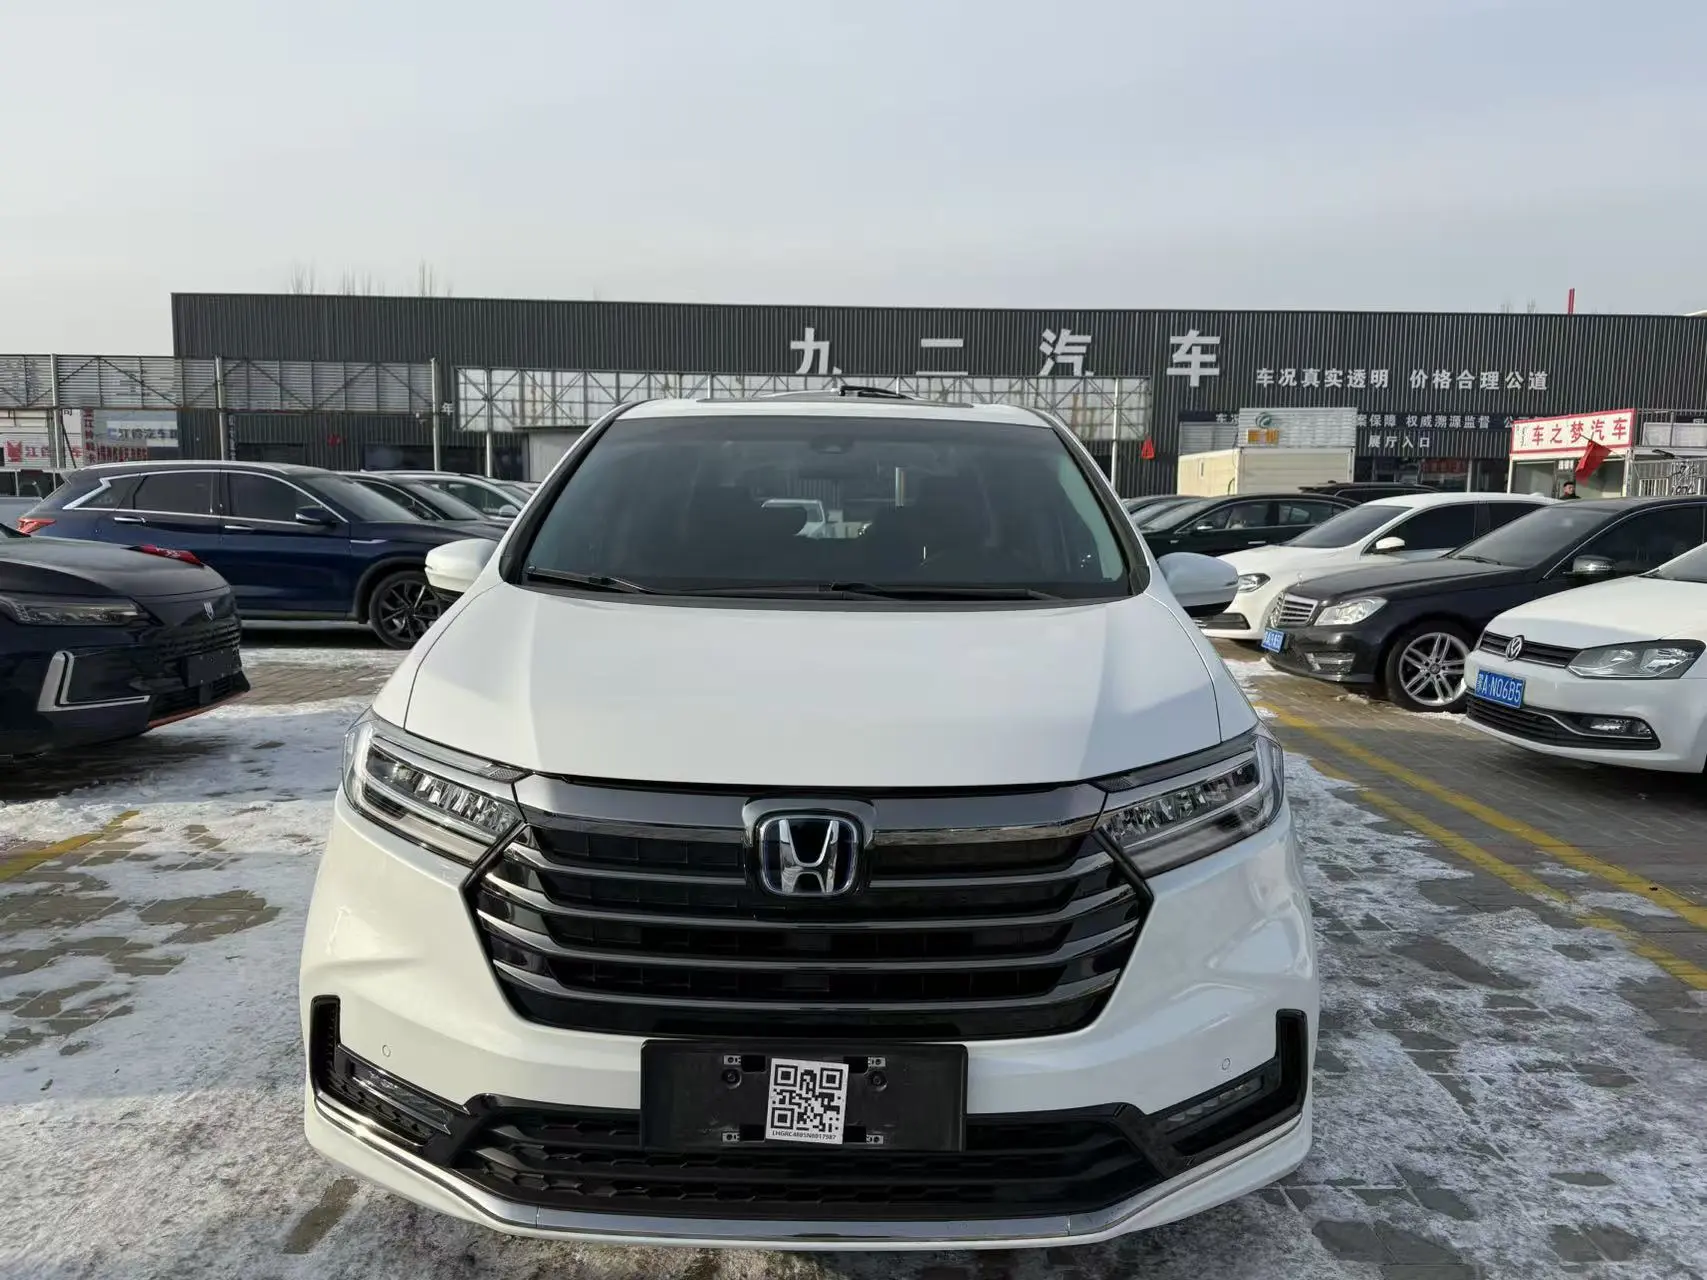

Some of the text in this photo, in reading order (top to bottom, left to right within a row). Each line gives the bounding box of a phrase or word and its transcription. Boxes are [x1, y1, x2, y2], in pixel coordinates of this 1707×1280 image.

[790, 327, 1221, 388] 九二汽车
[1255, 367, 1549, 391] 车况真实透明 价格合理公道
[1367, 434, 1431, 449] 展厅入口
[1531, 416, 1628, 446] 车之梦汽车
